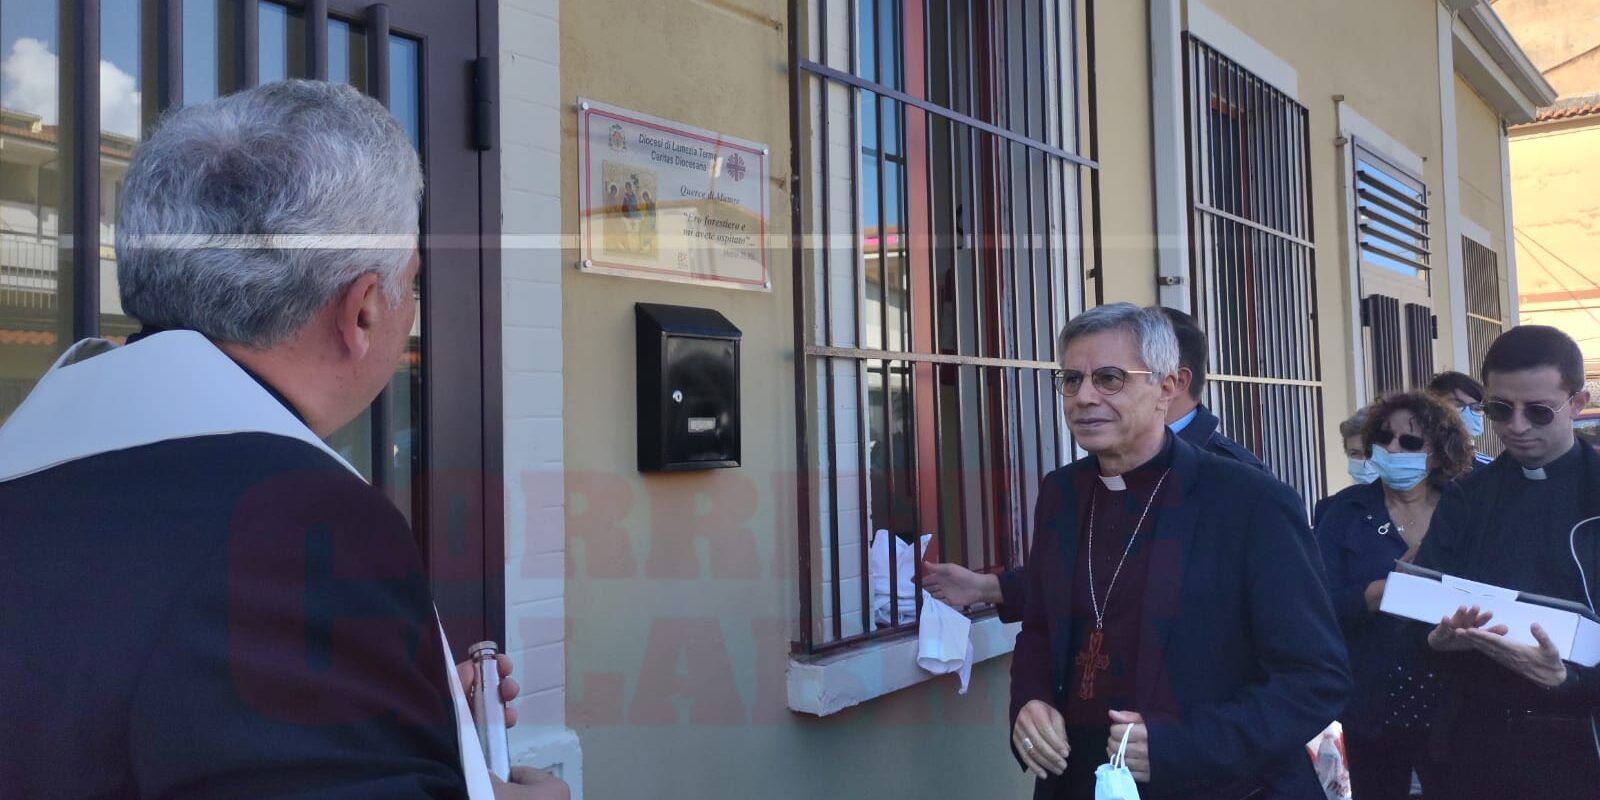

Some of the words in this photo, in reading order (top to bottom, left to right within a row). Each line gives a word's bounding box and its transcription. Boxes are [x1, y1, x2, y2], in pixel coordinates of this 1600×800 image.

[638, 133, 663, 148] Diocesi
[665, 140, 671, 150] di
[672, 140, 698, 155] Lamezia
[699, 148, 718, 162] Terme
[651, 150, 674, 164] Caritas
[680, 184, 706, 198] Querce
[707, 190, 714, 200] di
[704, 214, 740, 230] forestiero
[741, 223, 746, 231] e
[683, 229, 694, 237] mi
[695, 230, 714, 240] avete
